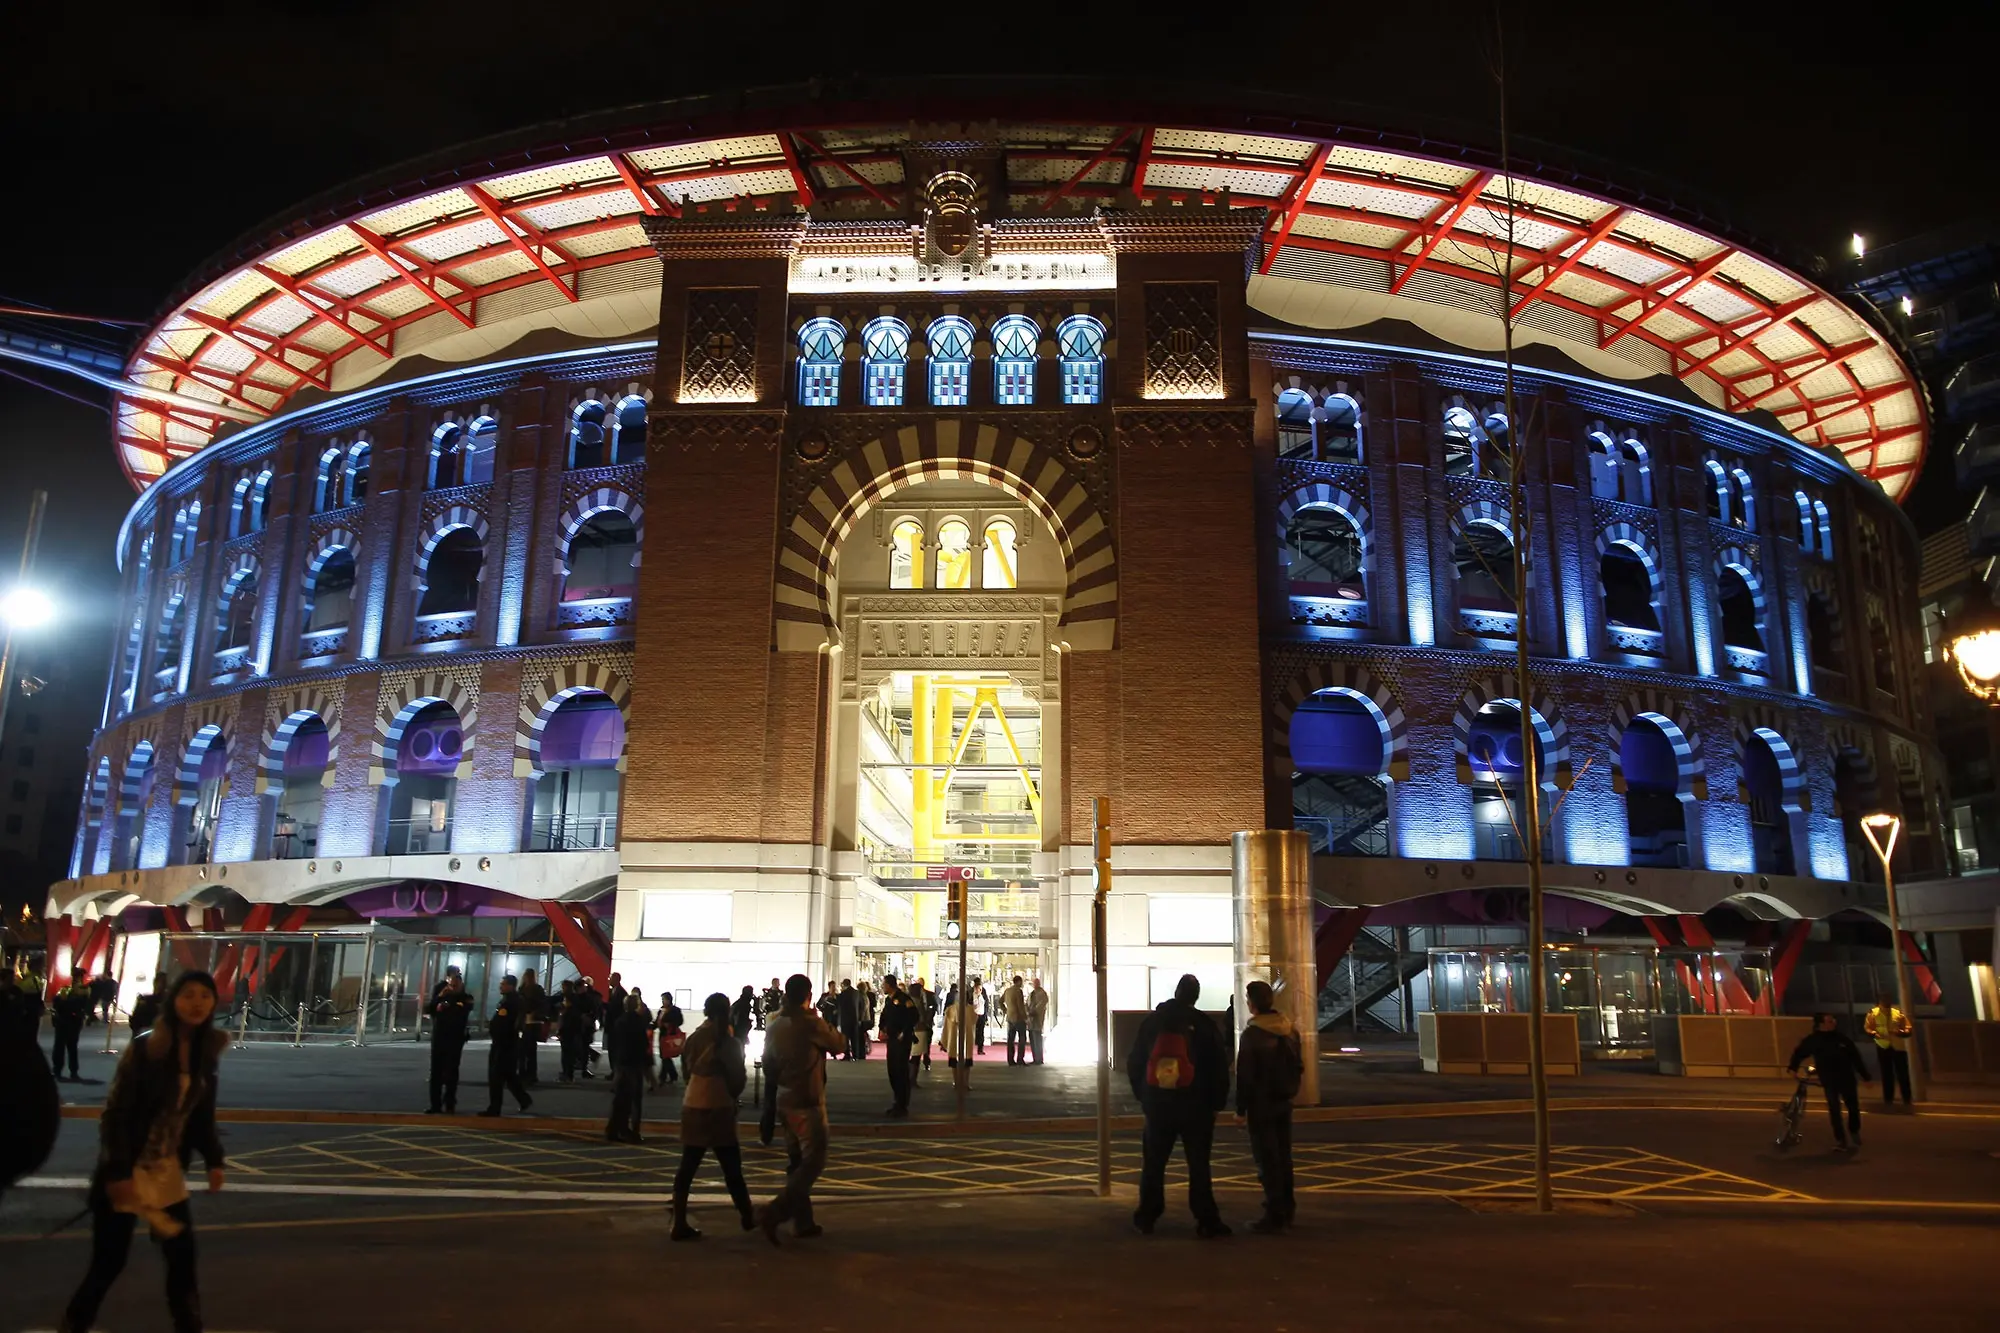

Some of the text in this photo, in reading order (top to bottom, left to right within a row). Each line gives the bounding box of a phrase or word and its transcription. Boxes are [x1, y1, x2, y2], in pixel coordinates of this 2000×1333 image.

[815, 263, 1091, 283] ARENAS DE BARCELONA
